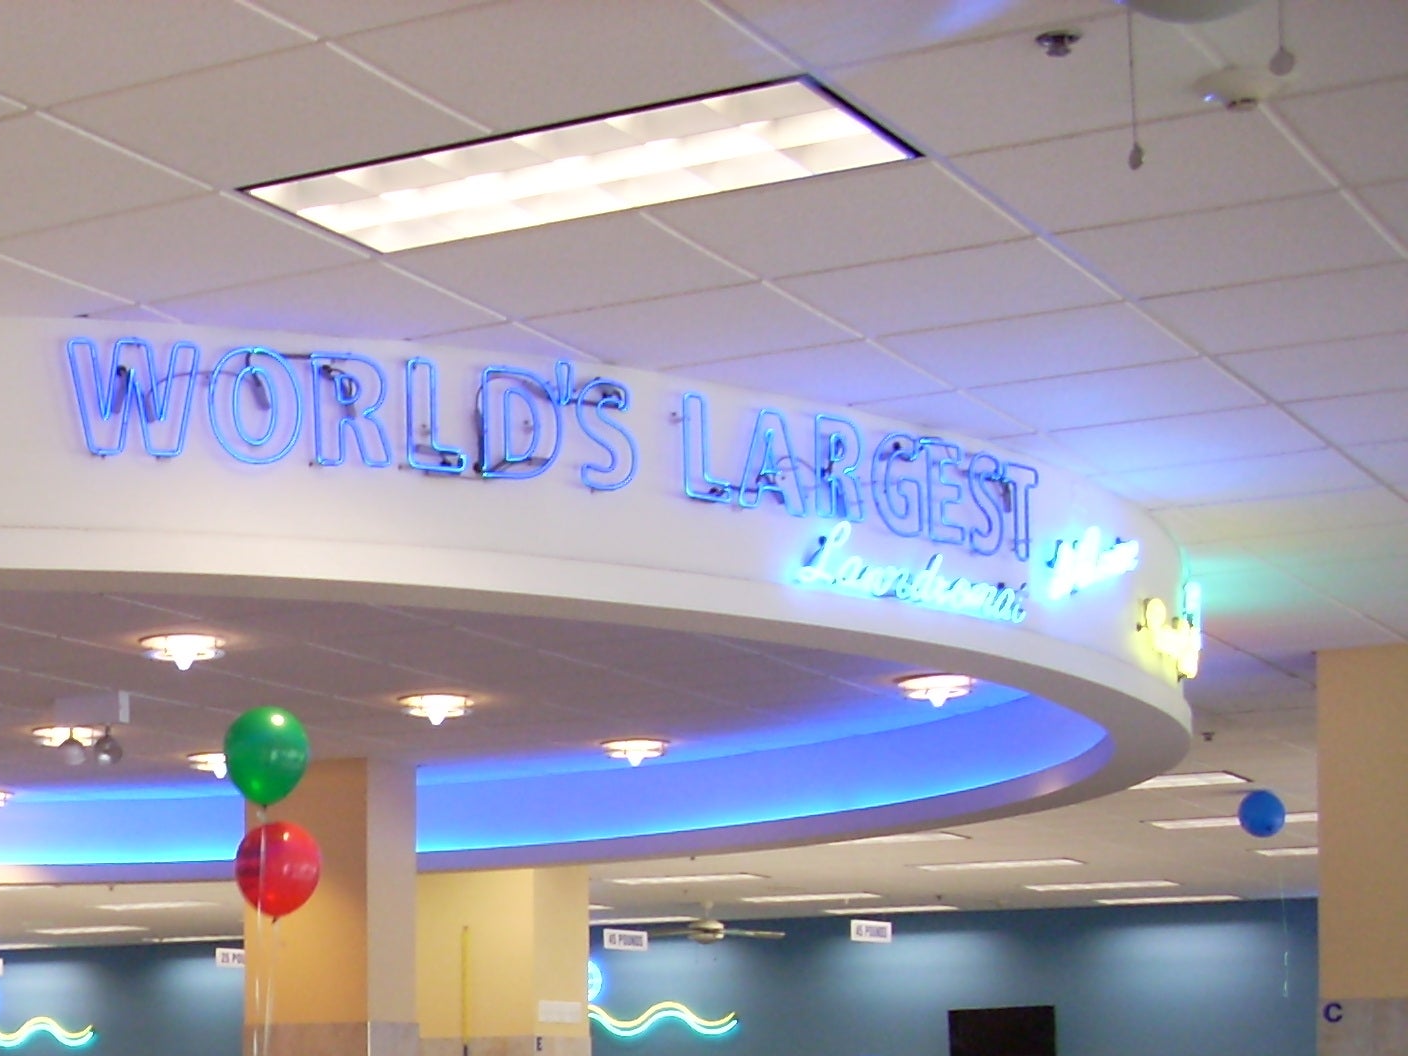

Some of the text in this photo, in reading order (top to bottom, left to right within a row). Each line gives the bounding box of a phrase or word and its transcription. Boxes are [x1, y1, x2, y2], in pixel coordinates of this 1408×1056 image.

[66, 336, 1039, 562] WORLD'S LARGEST
[1323, 1002, 1343, 1023] C
